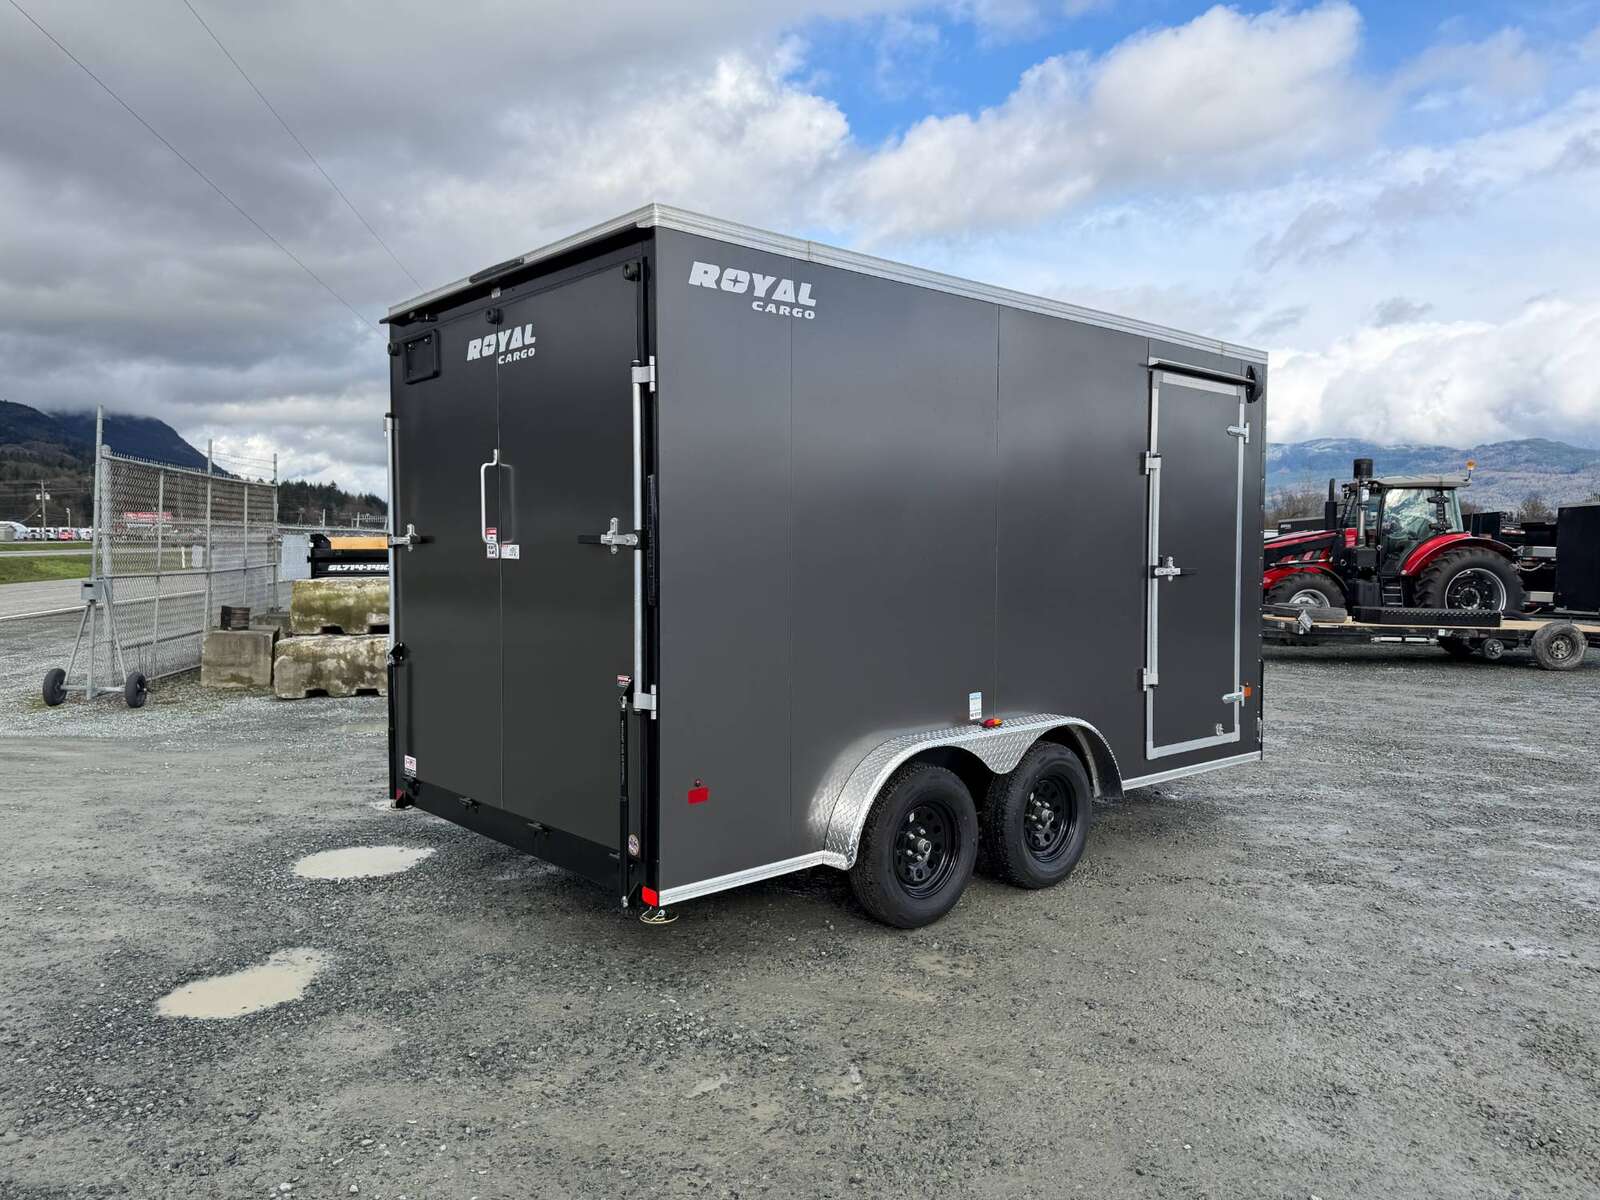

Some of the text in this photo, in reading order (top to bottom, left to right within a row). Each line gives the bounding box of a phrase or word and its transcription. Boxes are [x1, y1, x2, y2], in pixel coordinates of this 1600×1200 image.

[688, 261, 817, 307] ROYAL
[752, 301, 815, 320] CARGO
[466, 323, 536, 361] ROYAL
[498, 347, 536, 365] CARGO
